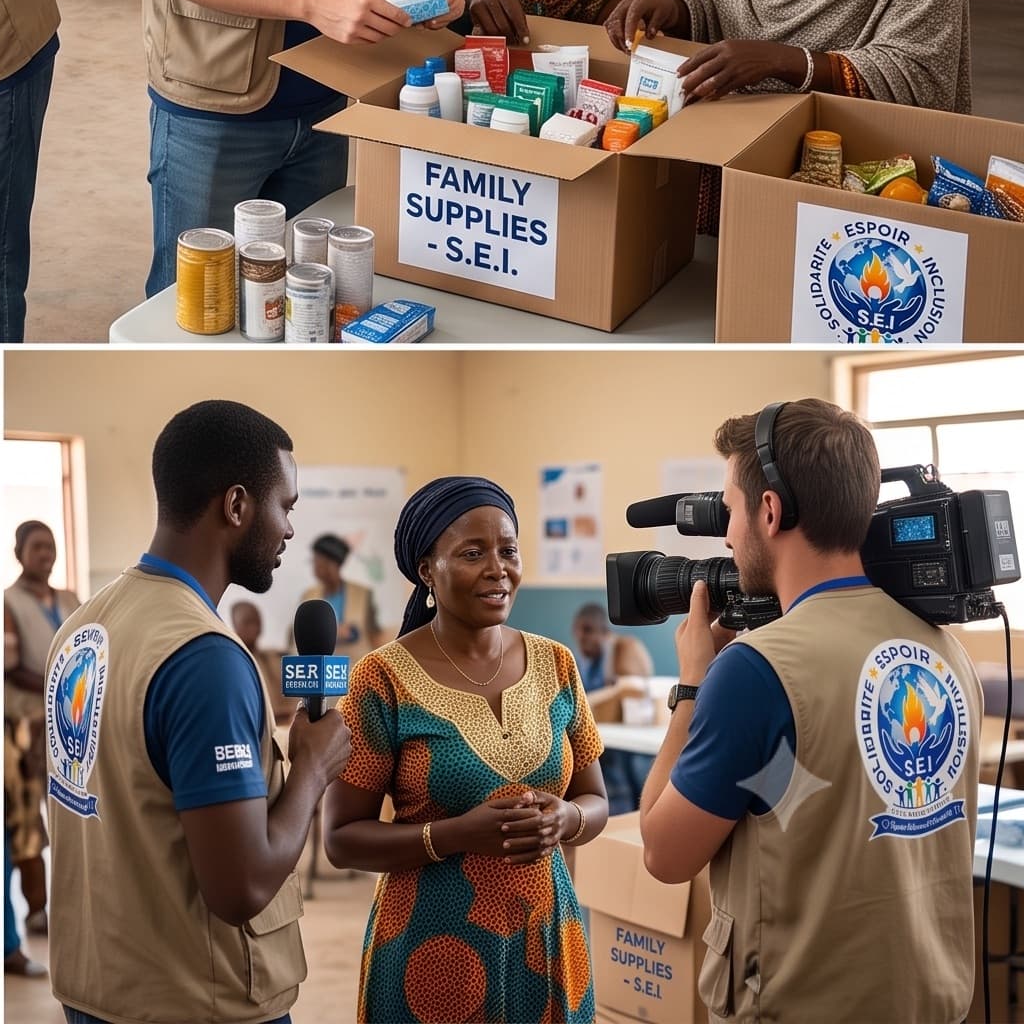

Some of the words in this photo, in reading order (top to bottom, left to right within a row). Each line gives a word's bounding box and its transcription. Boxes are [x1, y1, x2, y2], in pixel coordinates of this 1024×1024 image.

[425, 161, 532, 207] FAMILY
[406, 192, 548, 246] SUPPLIES
[844, 221, 911, 246] ESPOIR
[445, 236, 519, 276] S.E.I.
[809, 238, 841, 330] SOLIDARITE
[914, 257, 946, 343] INCLUSION
[857, 309, 895, 330] S.E.I
[616, 927, 666, 956] FAMILY
[611, 947, 673, 980] SUPPLIES
